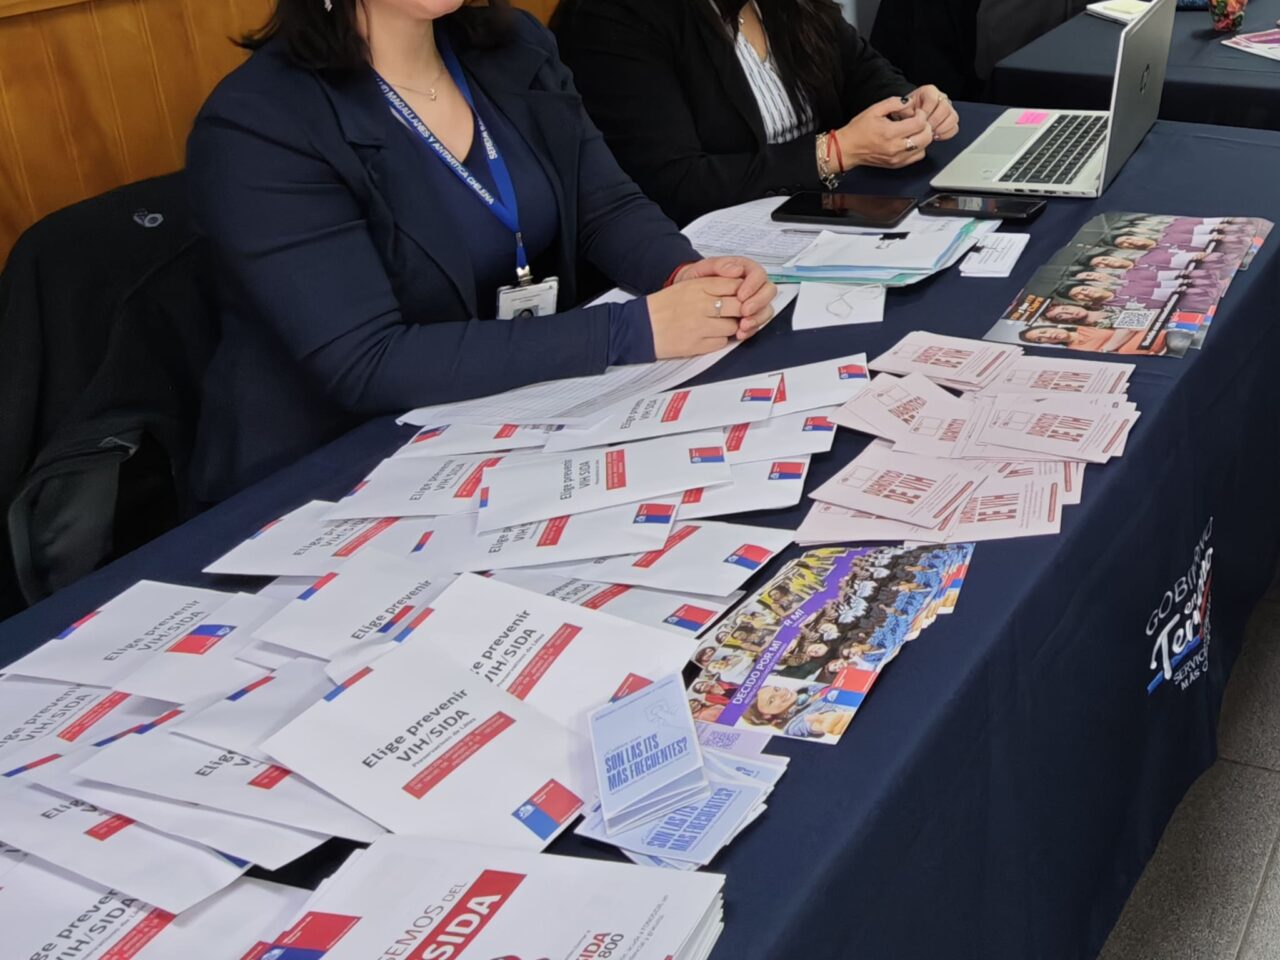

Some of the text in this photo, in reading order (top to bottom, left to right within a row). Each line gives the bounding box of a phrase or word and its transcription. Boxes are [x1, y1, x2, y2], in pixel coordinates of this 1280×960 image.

[103, 599, 201, 661] Elige prevenir
[351, 579, 432, 641] Elige prevenir
[482, 609, 532, 662] prevenir
[732, 670, 760, 705] DECIDO
[758, 652, 774, 671] POR
[361, 734, 407, 769] Elige
[405, 688, 469, 734] prevenir
[396, 707, 470, 764] VIH/SIDA
[604, 748, 626, 774] SON
[625, 740, 645, 764] LAS
[630, 736, 688, 784] FRECUENTES?
[442, 882, 469, 903] DEL
